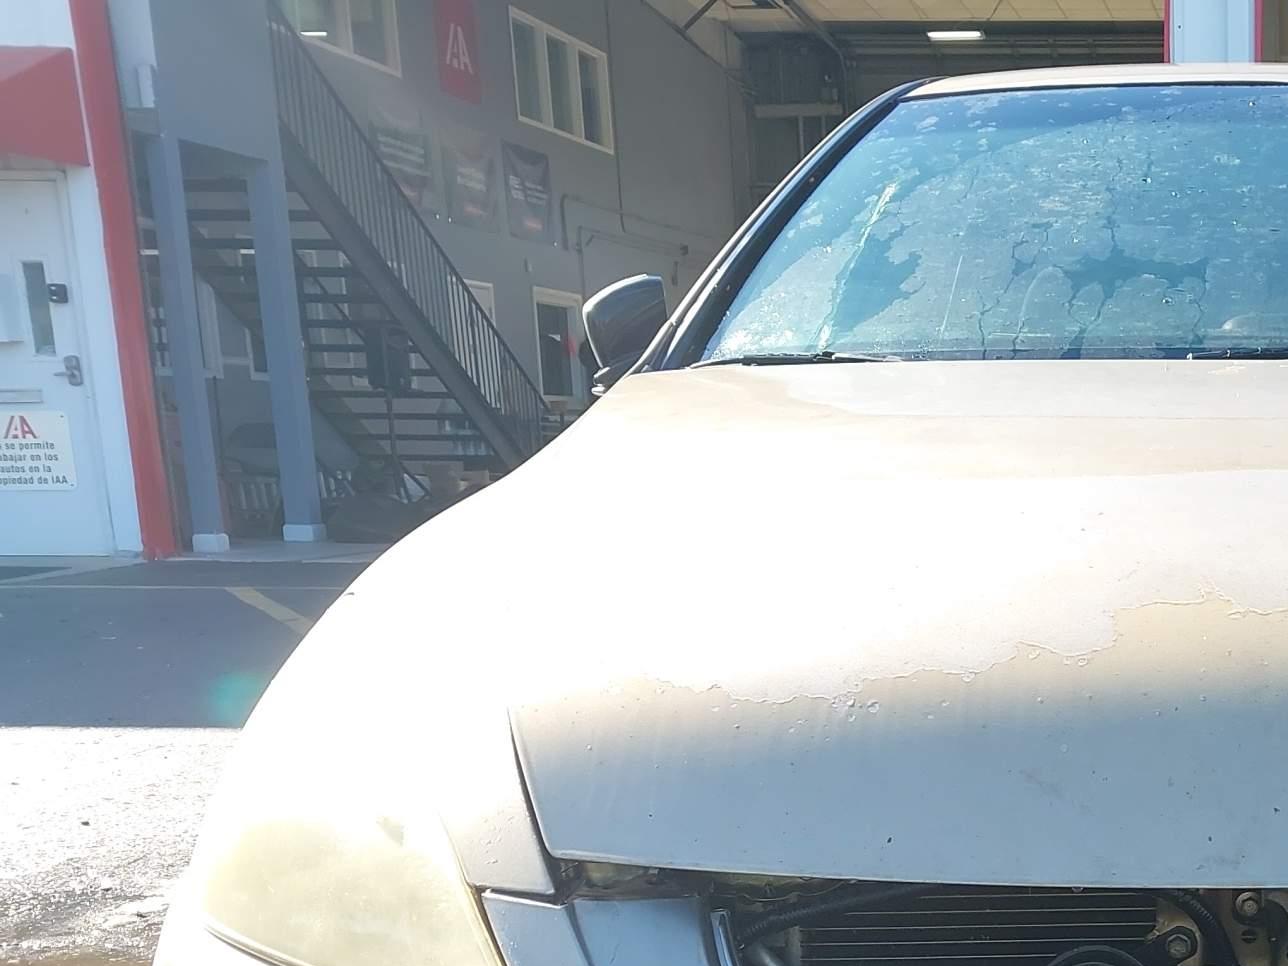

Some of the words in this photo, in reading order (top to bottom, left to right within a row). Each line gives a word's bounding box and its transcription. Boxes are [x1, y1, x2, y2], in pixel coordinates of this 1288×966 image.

[5, 442, 15, 450] se
[18, 442, 55, 451] permite
[44, 452, 59, 461] los
[29, 465, 40, 473] en
[43, 464, 52, 473] la
[37, 476, 48, 484] de
[52, 475, 68, 484] IAA
